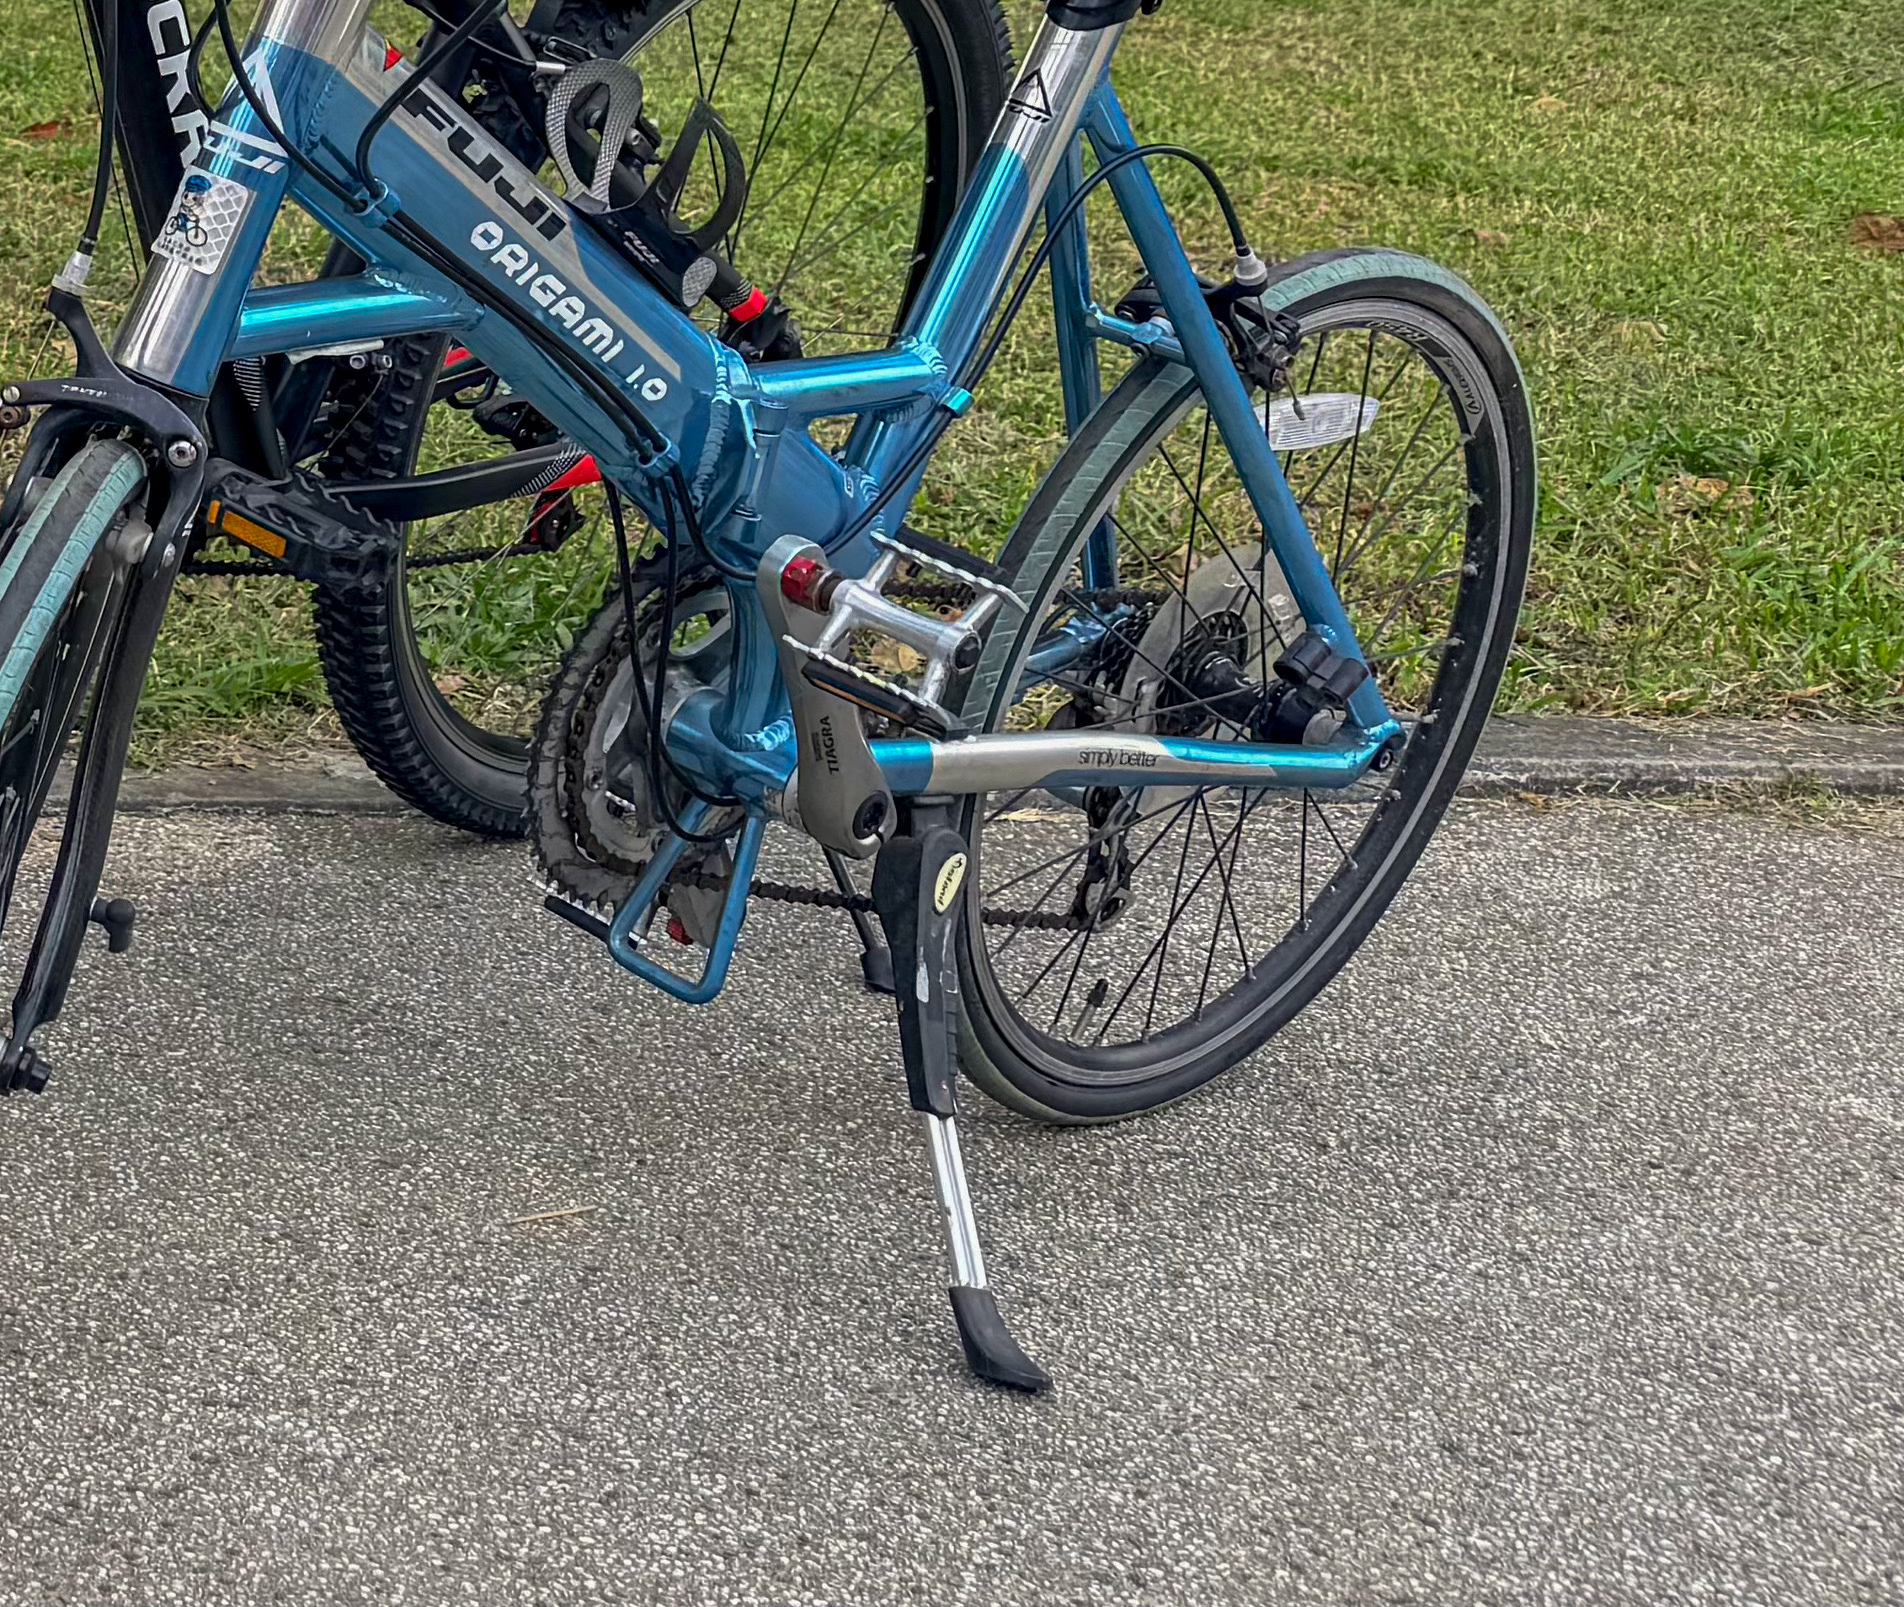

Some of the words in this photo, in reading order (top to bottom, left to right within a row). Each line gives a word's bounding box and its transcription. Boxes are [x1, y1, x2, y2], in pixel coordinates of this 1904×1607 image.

[401, 88, 567, 241] FUJI
[470, 221, 624, 363] ORIGAMI
[625, 364, 668, 402] 1.0
[818, 715, 840, 775] TIAGRA
[1078, 748, 1118, 769] simply
[1119, 748, 1160, 767] better
